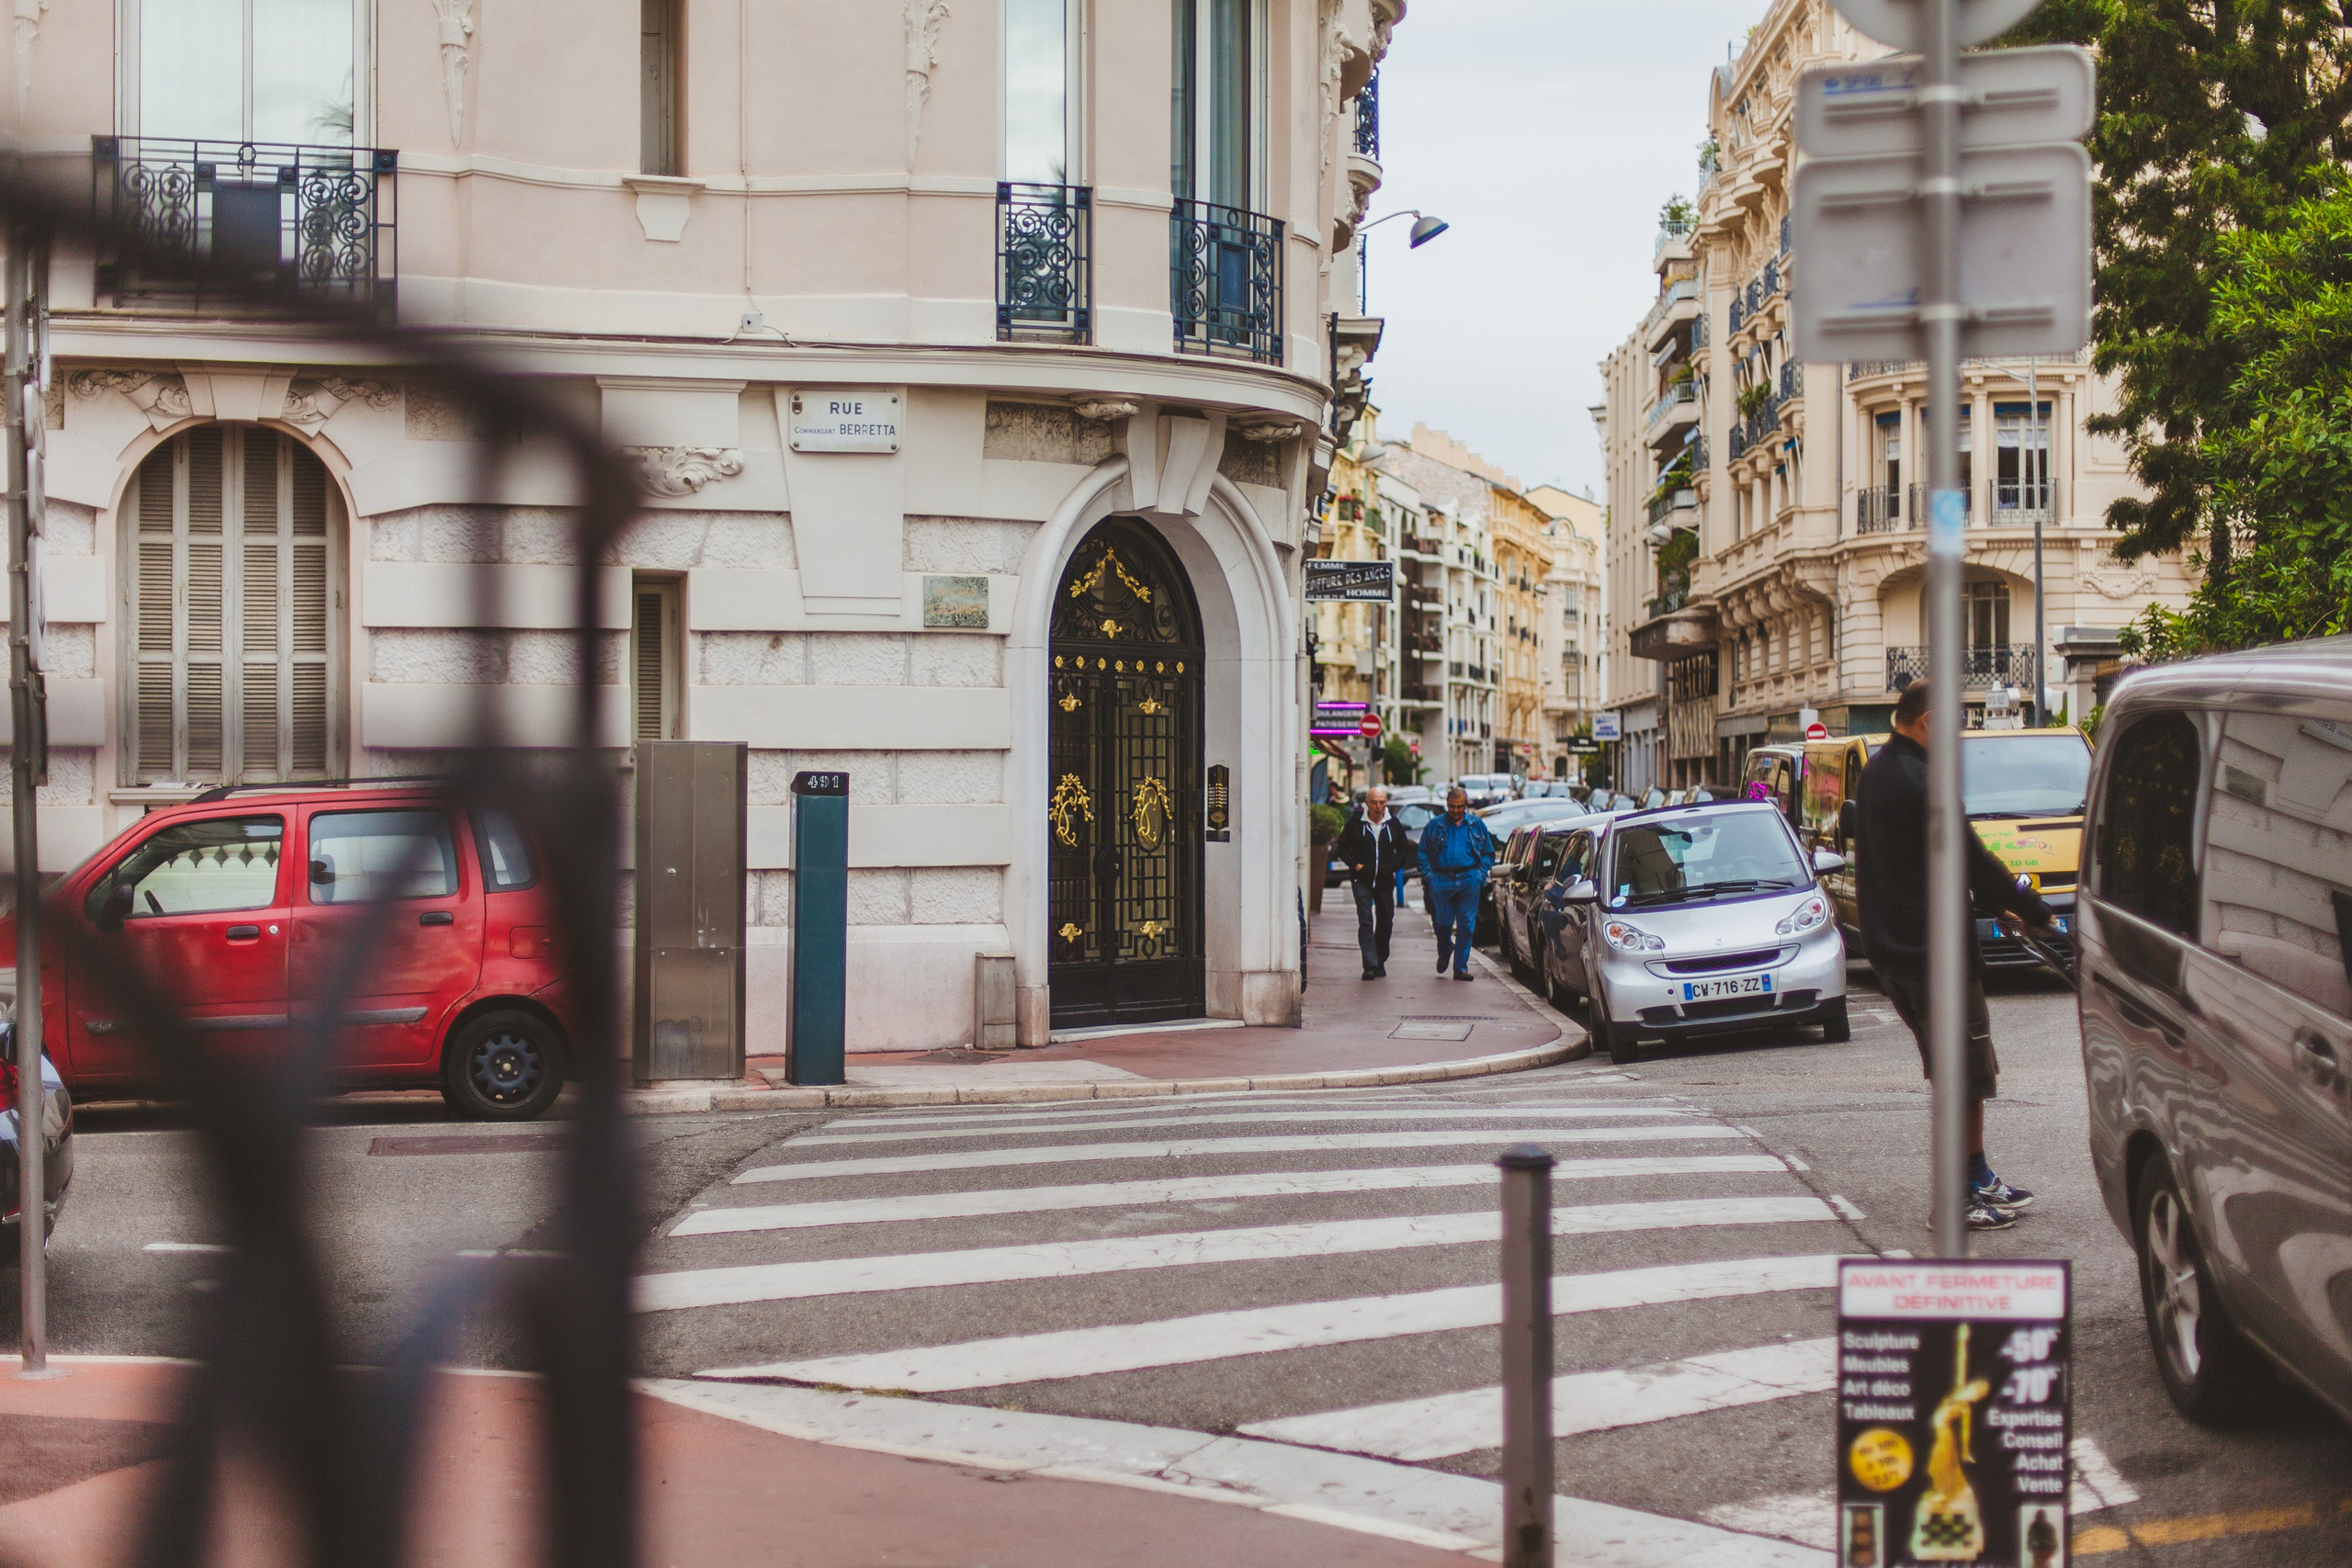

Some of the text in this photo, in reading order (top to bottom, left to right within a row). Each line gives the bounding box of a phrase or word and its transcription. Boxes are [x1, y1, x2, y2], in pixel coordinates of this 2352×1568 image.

[830, 401, 863, 415] RUE
[840, 423, 896, 436] BERRETTA
[1306, 567, 1391, 592] COIFFURE DES ANGES
[1346, 589, 1389, 597] HOMME
[1674, 653, 1711, 705] RIALTO
[808, 775, 839, 788] 491
[1692, 978, 1759, 998] CW-716-ZZ
[1848, 1274, 2060, 1291] AVANT FERMETURE
[1894, 1292, 2012, 1311] DÉFINITIVE
[1843, 1332, 1919, 1353] Sculpture
[1843, 1357, 1910, 1373] Meubles
[1843, 1380, 1910, 1396] Art déco
[1843, 1404, 1916, 1421] Tableaux
[1988, 1409, 2064, 1430] Expertise
[2003, 1432, 2064, 1449] Conseil
[2016, 1454, 2064, 1471] Achat
[2018, 1476, 2064, 1493] Vente
